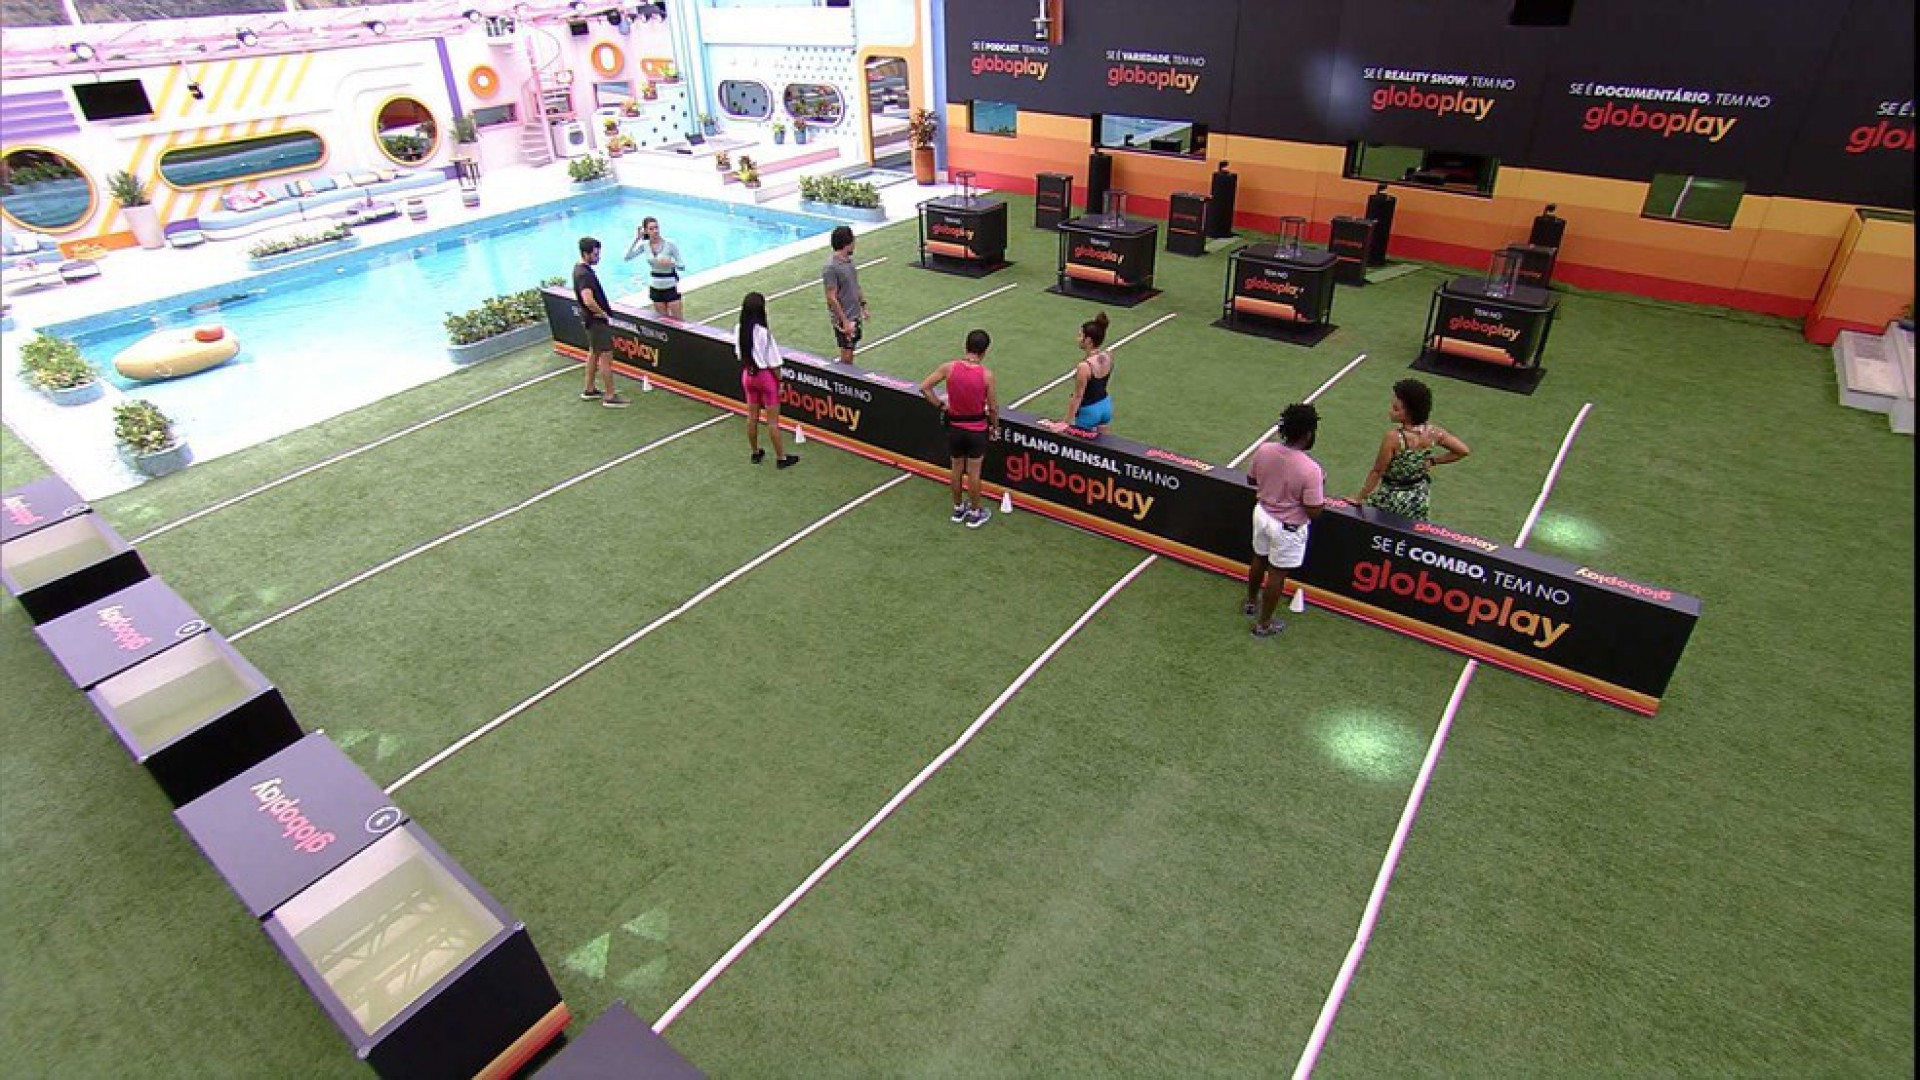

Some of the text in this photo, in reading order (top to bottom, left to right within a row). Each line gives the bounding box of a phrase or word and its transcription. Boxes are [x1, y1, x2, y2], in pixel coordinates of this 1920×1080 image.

[972, 53, 1048, 80] globoplay
[1108, 64, 1199, 94] globoplay
[1384, 69, 1430, 83] REALITY
[1430, 72, 1469, 87] SHOW,
[1472, 76, 1494, 89] TEM
[1496, 77, 1516, 90] NO
[1372, 84, 1495, 121] globoplay
[1569, 83, 1584, 95] SE
[1594, 85, 1711, 106] DOCUMENTÁRIO,
[1716, 93, 1744, 107] TEM
[1746, 95, 1771, 108] NO
[1876, 101, 1900, 116] SE
[1582, 101, 1737, 142] globoplay
[1449, 315, 1521, 342] globoplay
[833, 381, 854, 397] TEM
[854, 387, 872, 403] NO
[1004, 428, 1012, 443] É
[1014, 430, 1059, 455] PLANO
[1061, 445, 1121, 475] MENSAL,
[1124, 463, 1152, 484] TEM
[1154, 472, 1180, 490] NO
[1006, 452, 1154, 520] globoplay
[1413, 522, 1499, 552] globoplay
[1372, 535, 1570, 605] SE É COMBO, TEM NO
[1351, 559, 1571, 648] globoplay
[250, 777, 337, 853] globoplay
